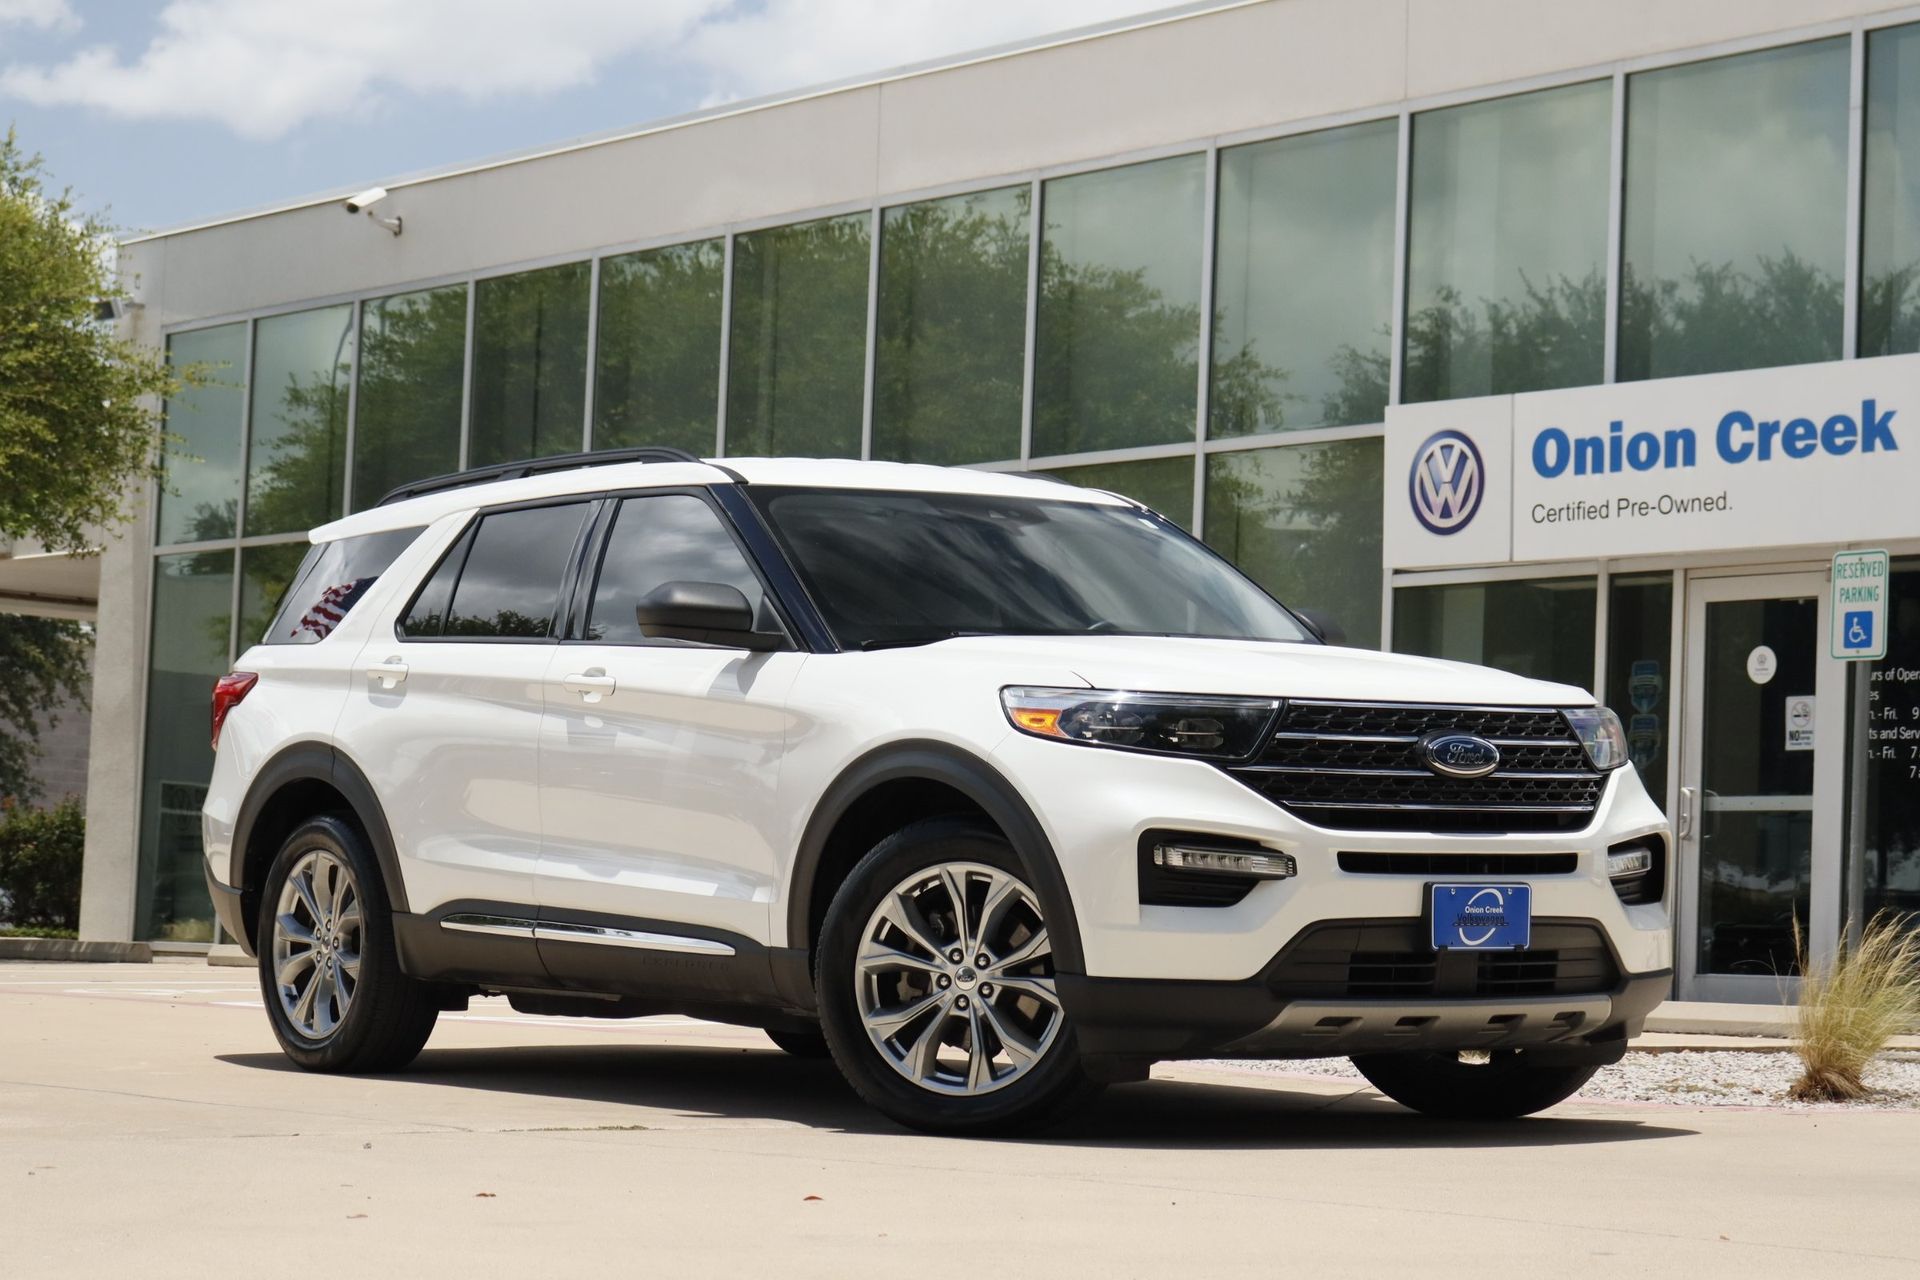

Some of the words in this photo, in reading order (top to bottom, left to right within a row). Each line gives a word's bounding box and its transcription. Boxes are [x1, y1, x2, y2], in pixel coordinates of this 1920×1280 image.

[1532, 420, 1696, 478] Onion
[1716, 399, 1898, 464] Creek
[1531, 497, 1610, 525] Certified
[1617, 491, 1733, 519] Pre-Owned.
[1836, 560, 1884, 580] RESERVED
[1839, 586, 1880, 603] PARKING
[1885, 667, 1895, 681] of
[1897, 667, 1920, 684] Oper
[1883, 706, 1898, 720] Fri.
[1912, 706, 1919, 720] 9
[1788, 730, 1800, 741] NO
[1879, 726, 1898, 740] and
[1447, 742, 1485, 764] Ford
[1882, 746, 1897, 759] Fri.
[1910, 746, 1918, 759] 7
[1909, 765, 1917, 779] 7
[1464, 905, 1484, 914] Onion
[1485, 905, 1504, 914] Creek
[1456, 913, 1505, 924] Volkswagen
